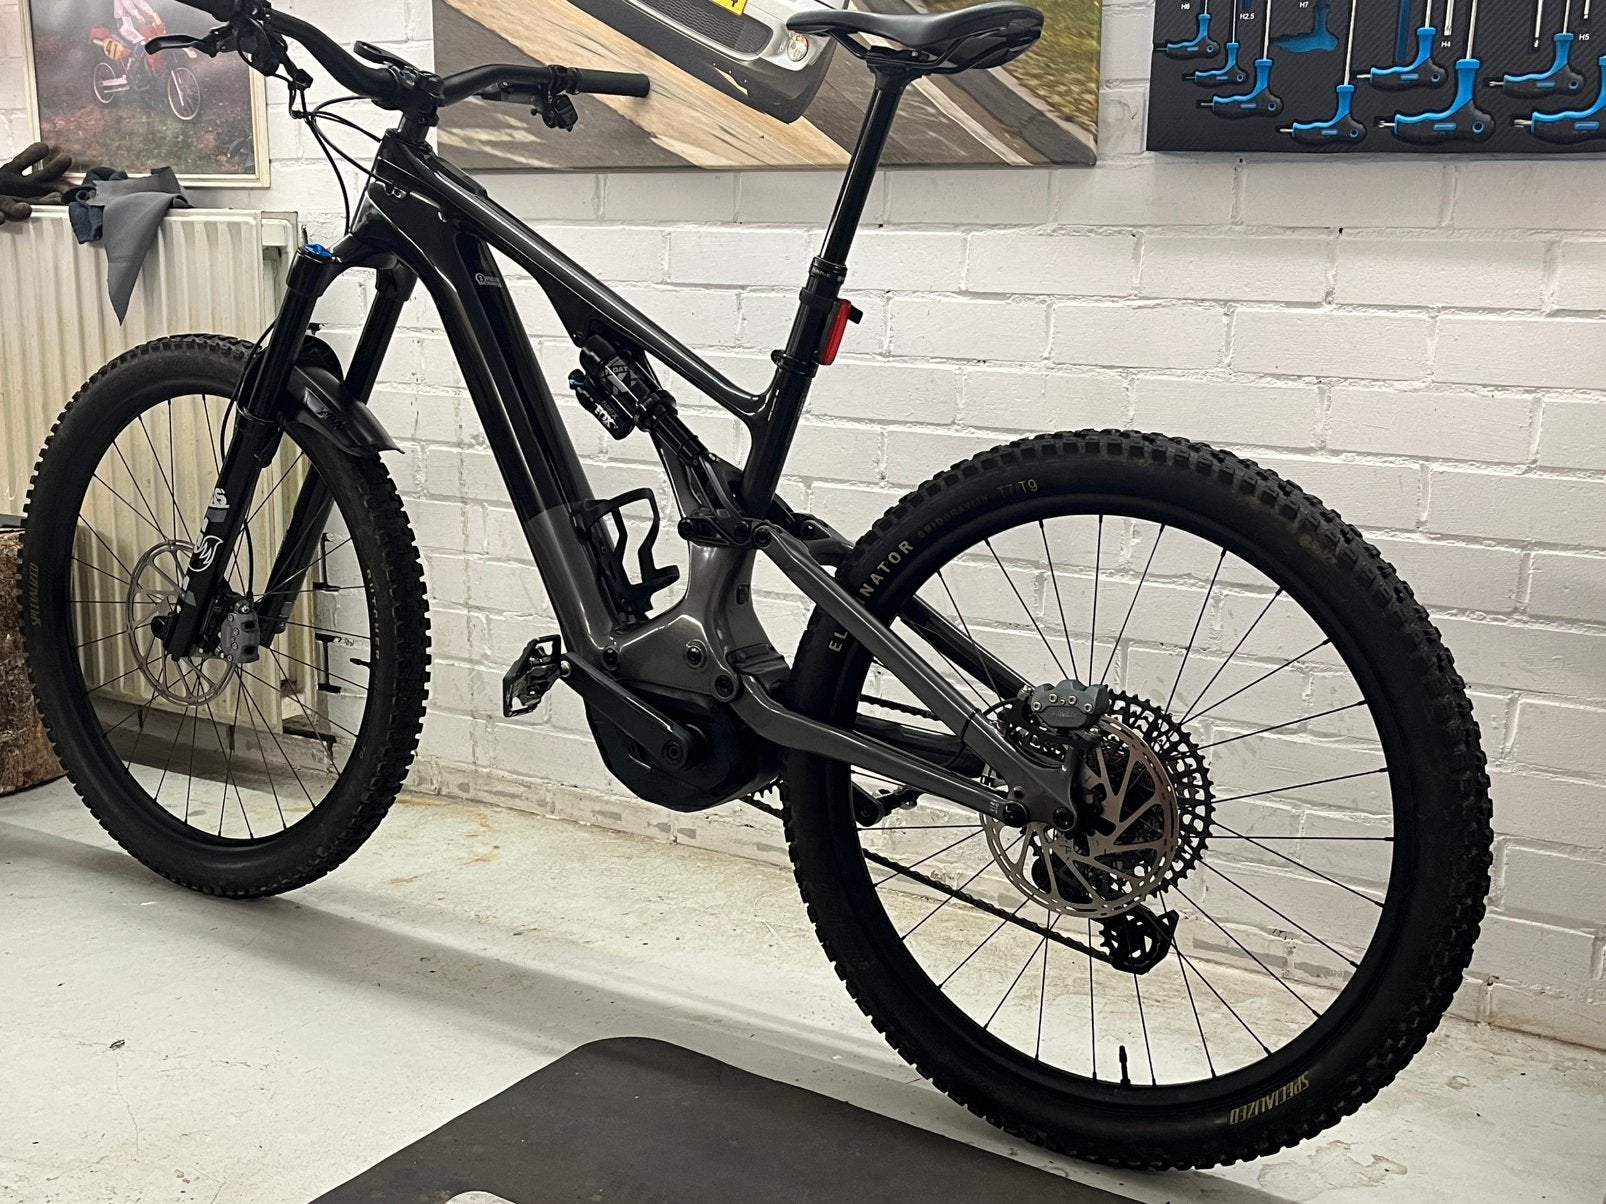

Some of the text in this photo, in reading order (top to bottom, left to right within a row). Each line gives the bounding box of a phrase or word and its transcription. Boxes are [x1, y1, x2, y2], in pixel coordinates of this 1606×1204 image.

[1579, 33, 1590, 41] H5
[1441, 40, 1451, 48] H4
[1229, 1070, 1309, 1125] SPECIALIZED
